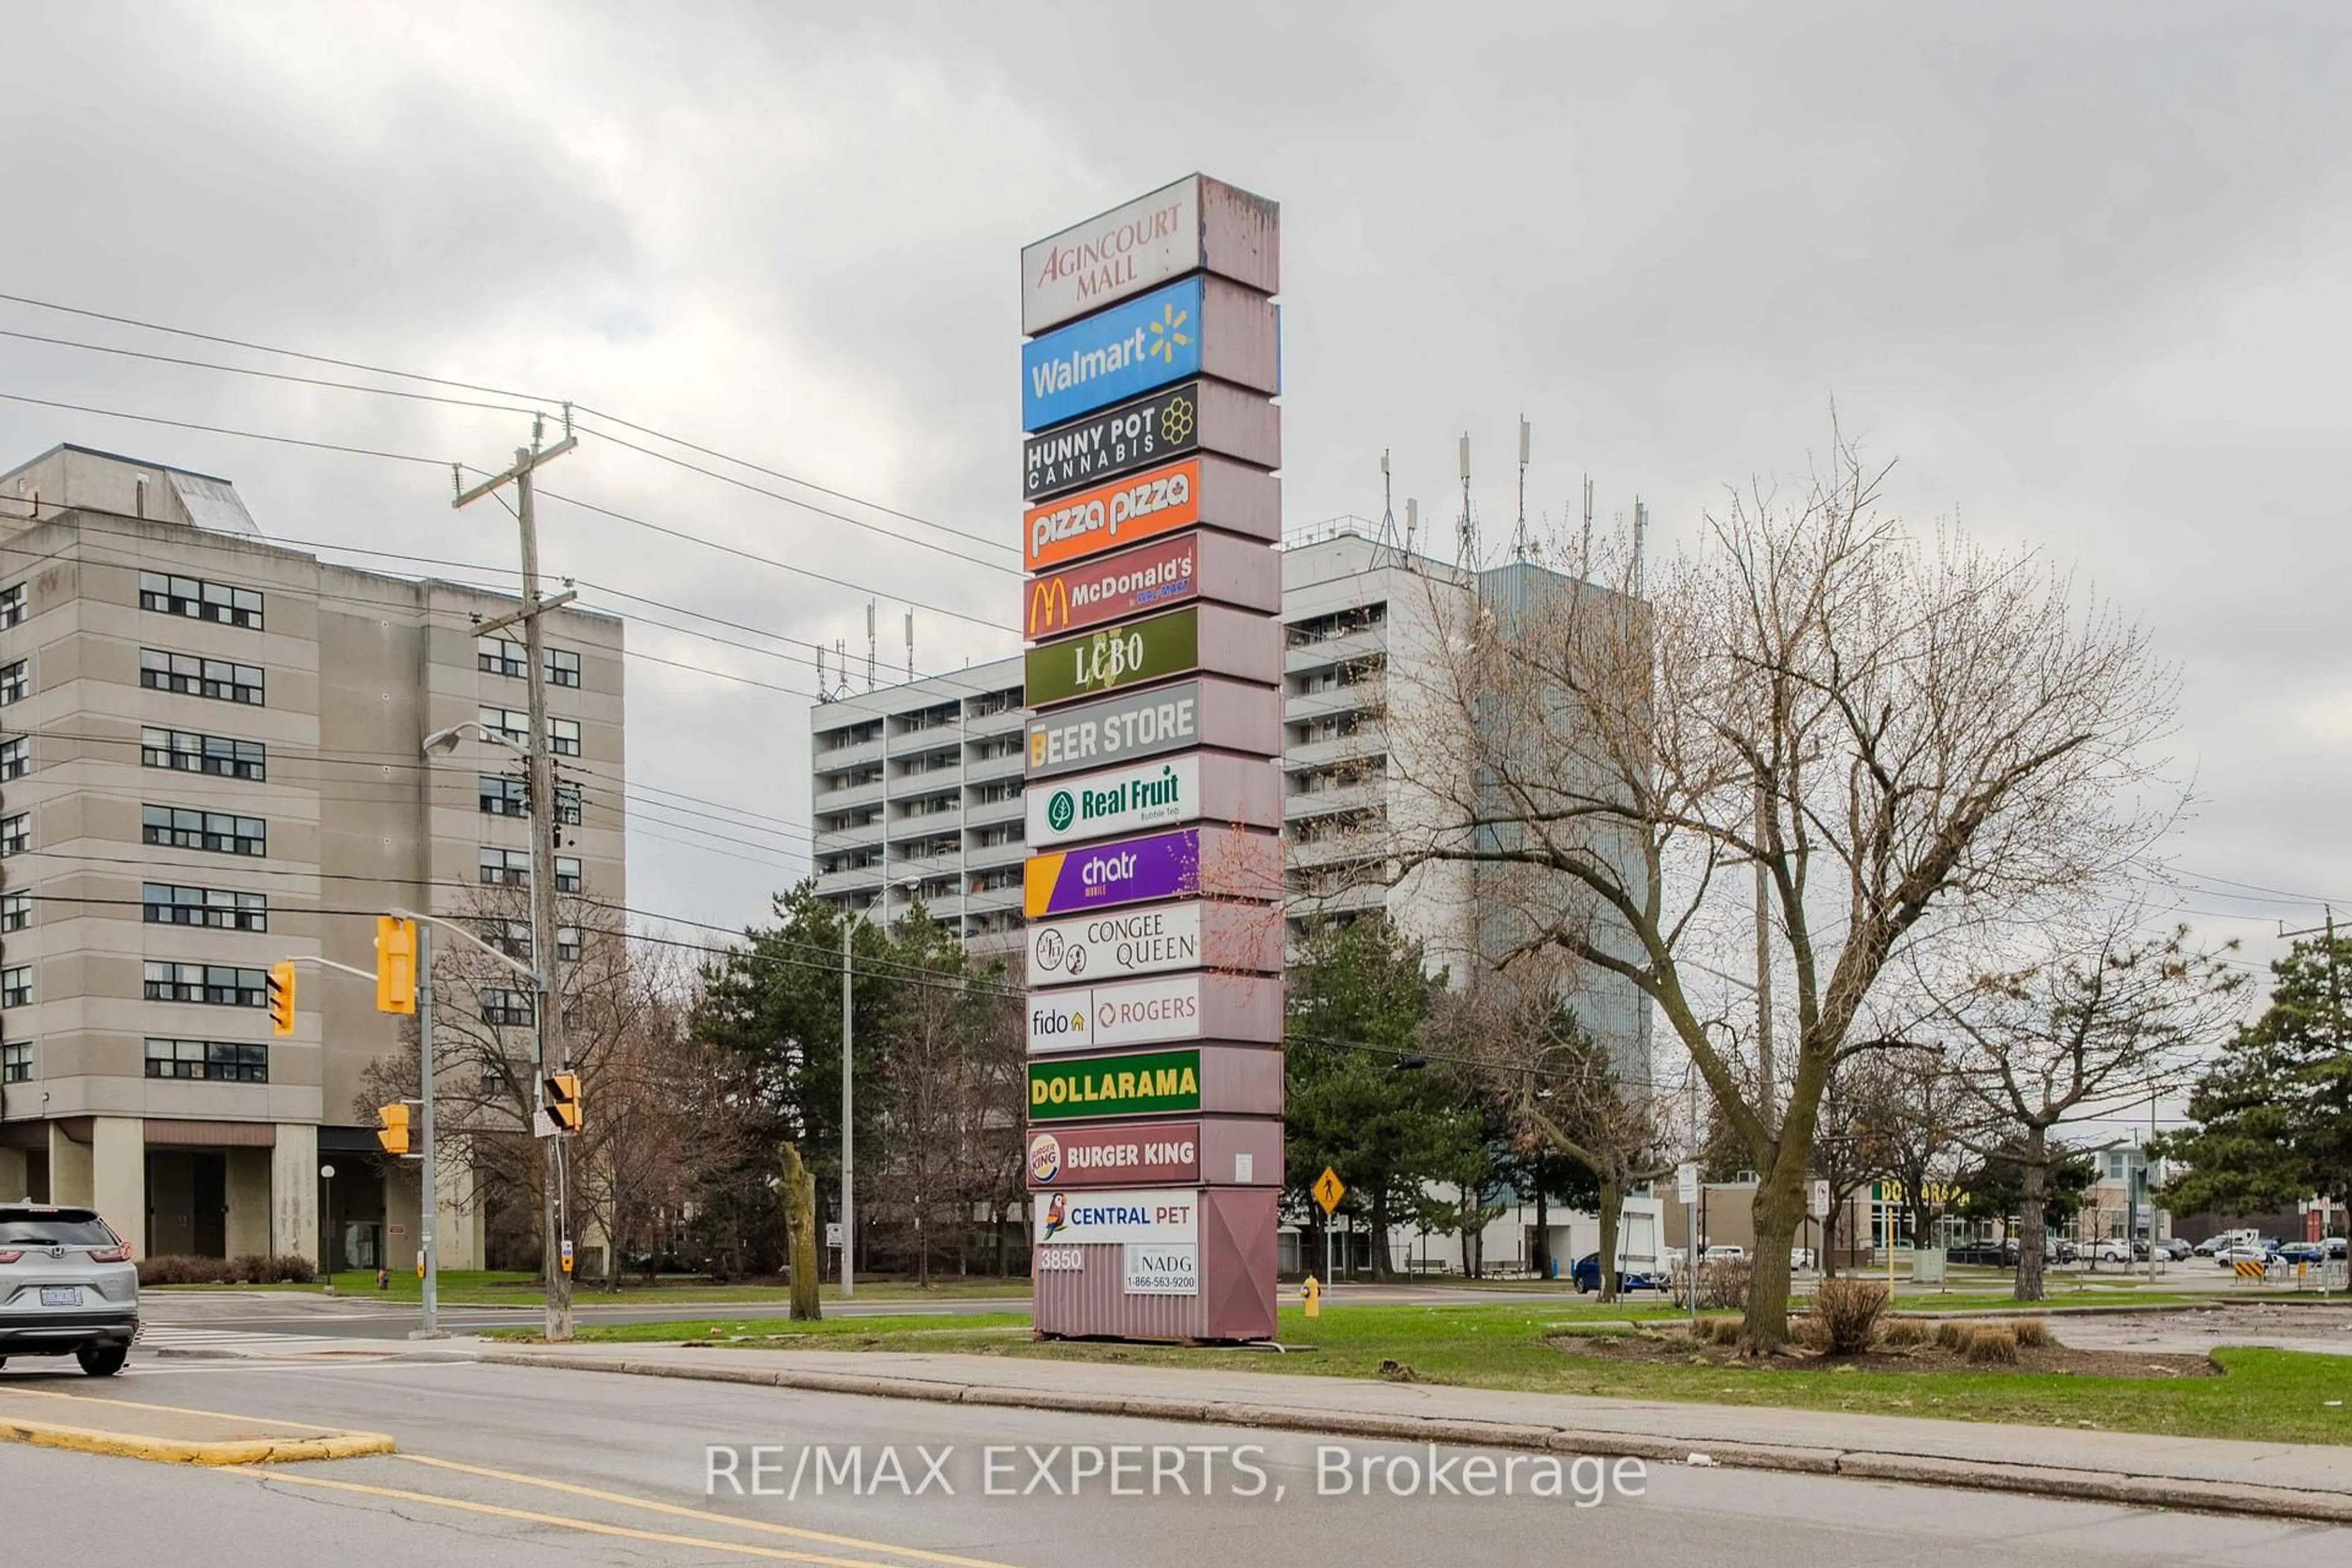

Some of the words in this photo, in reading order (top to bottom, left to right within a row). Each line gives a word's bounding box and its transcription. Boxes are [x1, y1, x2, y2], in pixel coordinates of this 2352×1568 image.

[1037, 203, 1183, 289] AGINCOURT
[1076, 254, 1138, 303] MALL
[1032, 326, 1145, 399] Walmart
[1028, 424, 1104, 471] HUNNY
[1111, 407, 1155, 444] POT
[1028, 432, 1154, 490] CANNABIS
[1072, 557, 1192, 608] McDonald's
[1075, 632, 1144, 685] LCBO
[1031, 720, 1097, 768] BEER
[1104, 698, 1194, 753] STORE
[1082, 783, 1126, 820] Real
[1132, 764, 1179, 810] Fruit
[1082, 851, 1137, 885] chatr
[1088, 914, 1164, 944] CONGEE
[1117, 935, 1194, 970] QUEEN
[1033, 1009, 1068, 1036] fido
[1121, 997, 1196, 1023] ROGERS
[1031, 1068, 1197, 1105] DOLLARAMA
[1068, 1144, 1139, 1169] BURGER
[1145, 1141, 1194, 1165] KING
[1071, 1207, 1151, 1225] CENTRAL
[1156, 1206, 1190, 1224] PET
[1041, 1250, 1082, 1270] 3850
[1142, 1256, 1192, 1273] NADG
[1128, 1276, 1195, 1288] 1-866-563-9200
